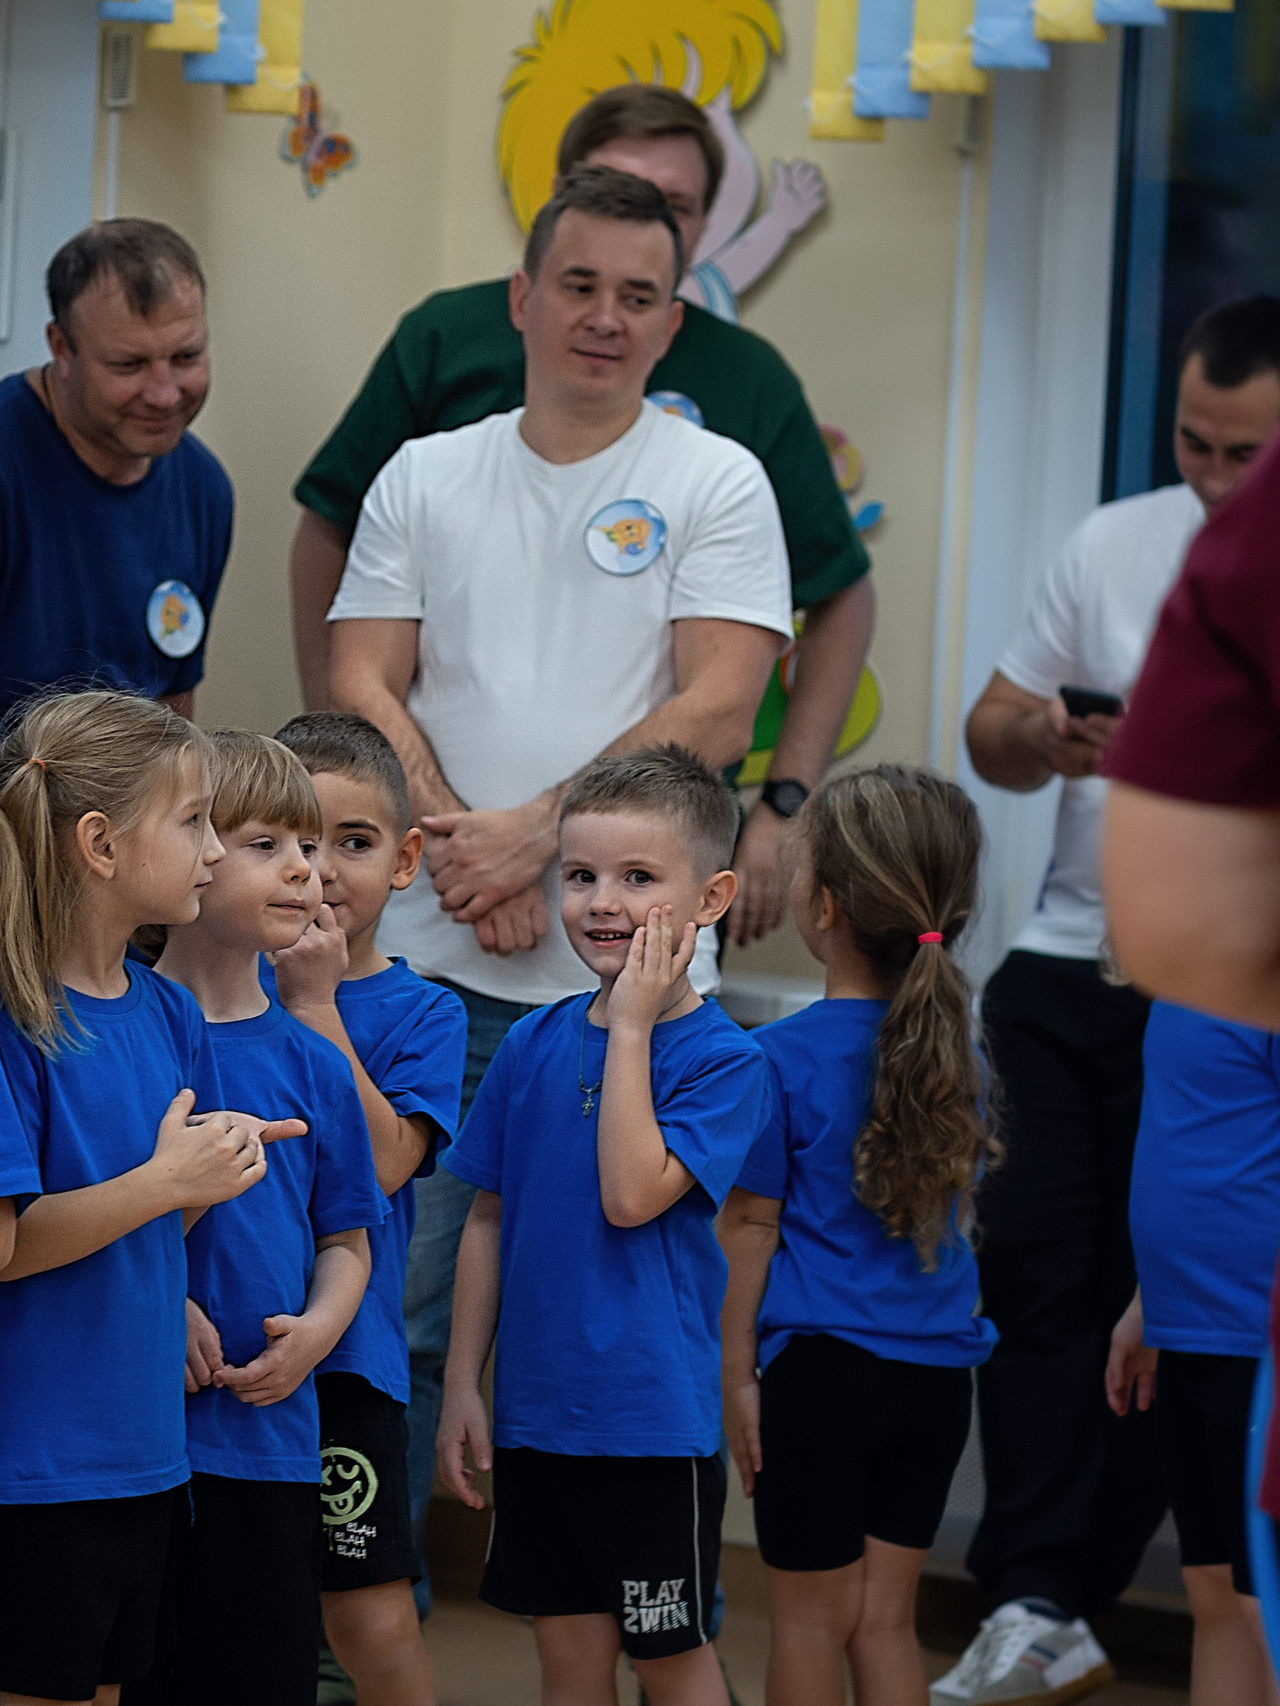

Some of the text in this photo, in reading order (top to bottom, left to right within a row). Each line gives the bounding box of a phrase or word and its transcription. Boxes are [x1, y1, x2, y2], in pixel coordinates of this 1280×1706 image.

[346, 1522, 377, 1537] BLAH
[335, 1531, 365, 1546] BLAH
[336, 1544, 367, 1559] BLAH
[622, 1578, 685, 1606] PLAY
[623, 1601, 689, 1633] 2WIN
